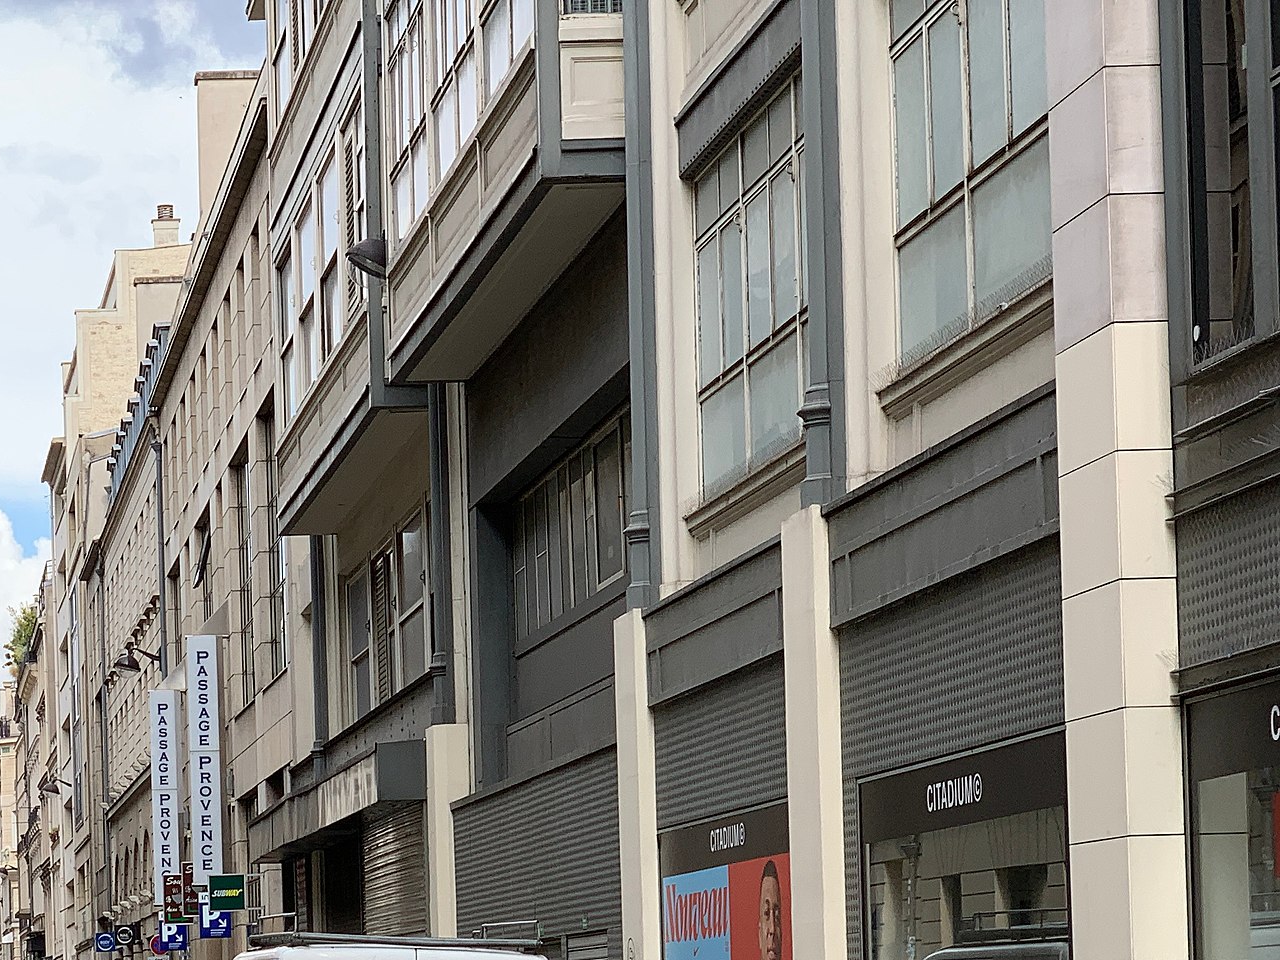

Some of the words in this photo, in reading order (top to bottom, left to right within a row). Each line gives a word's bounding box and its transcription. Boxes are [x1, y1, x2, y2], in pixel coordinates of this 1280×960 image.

[196, 650, 210, 746] PASSAGE
[157, 703, 169, 786] PASSAGE
[199, 755, 213, 871] PROVENCE
[211, 889, 243, 897] SUBWAY
[665, 883, 728, 944] Nouveau
